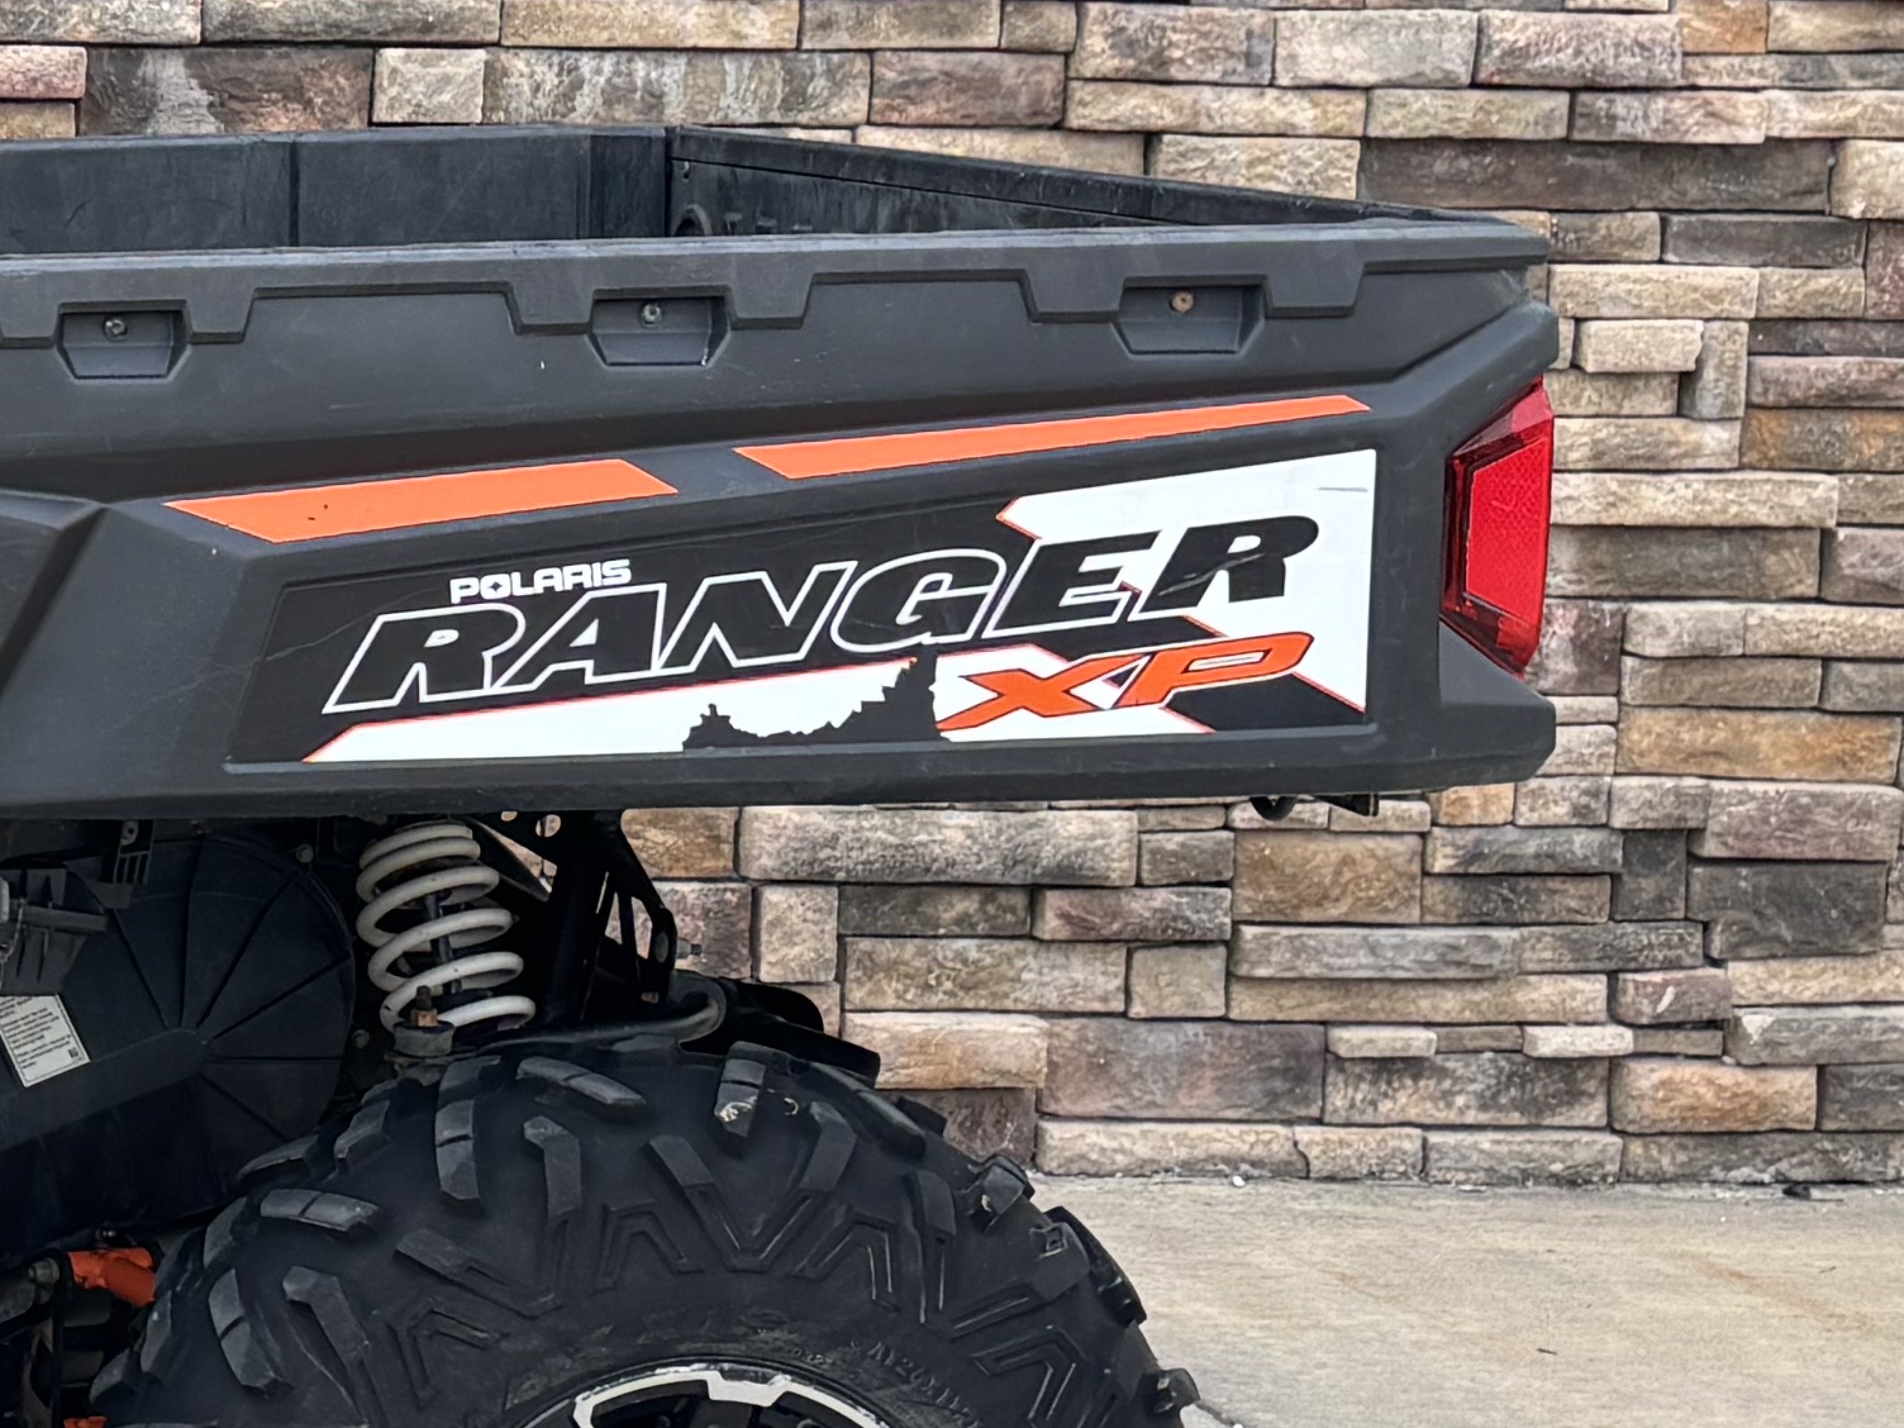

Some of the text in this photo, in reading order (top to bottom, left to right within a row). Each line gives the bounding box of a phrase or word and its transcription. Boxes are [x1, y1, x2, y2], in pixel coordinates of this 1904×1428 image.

[322, 515, 1321, 714] RANGER
[450, 558, 633, 605] POLARIS
[936, 630, 1315, 732] XP
